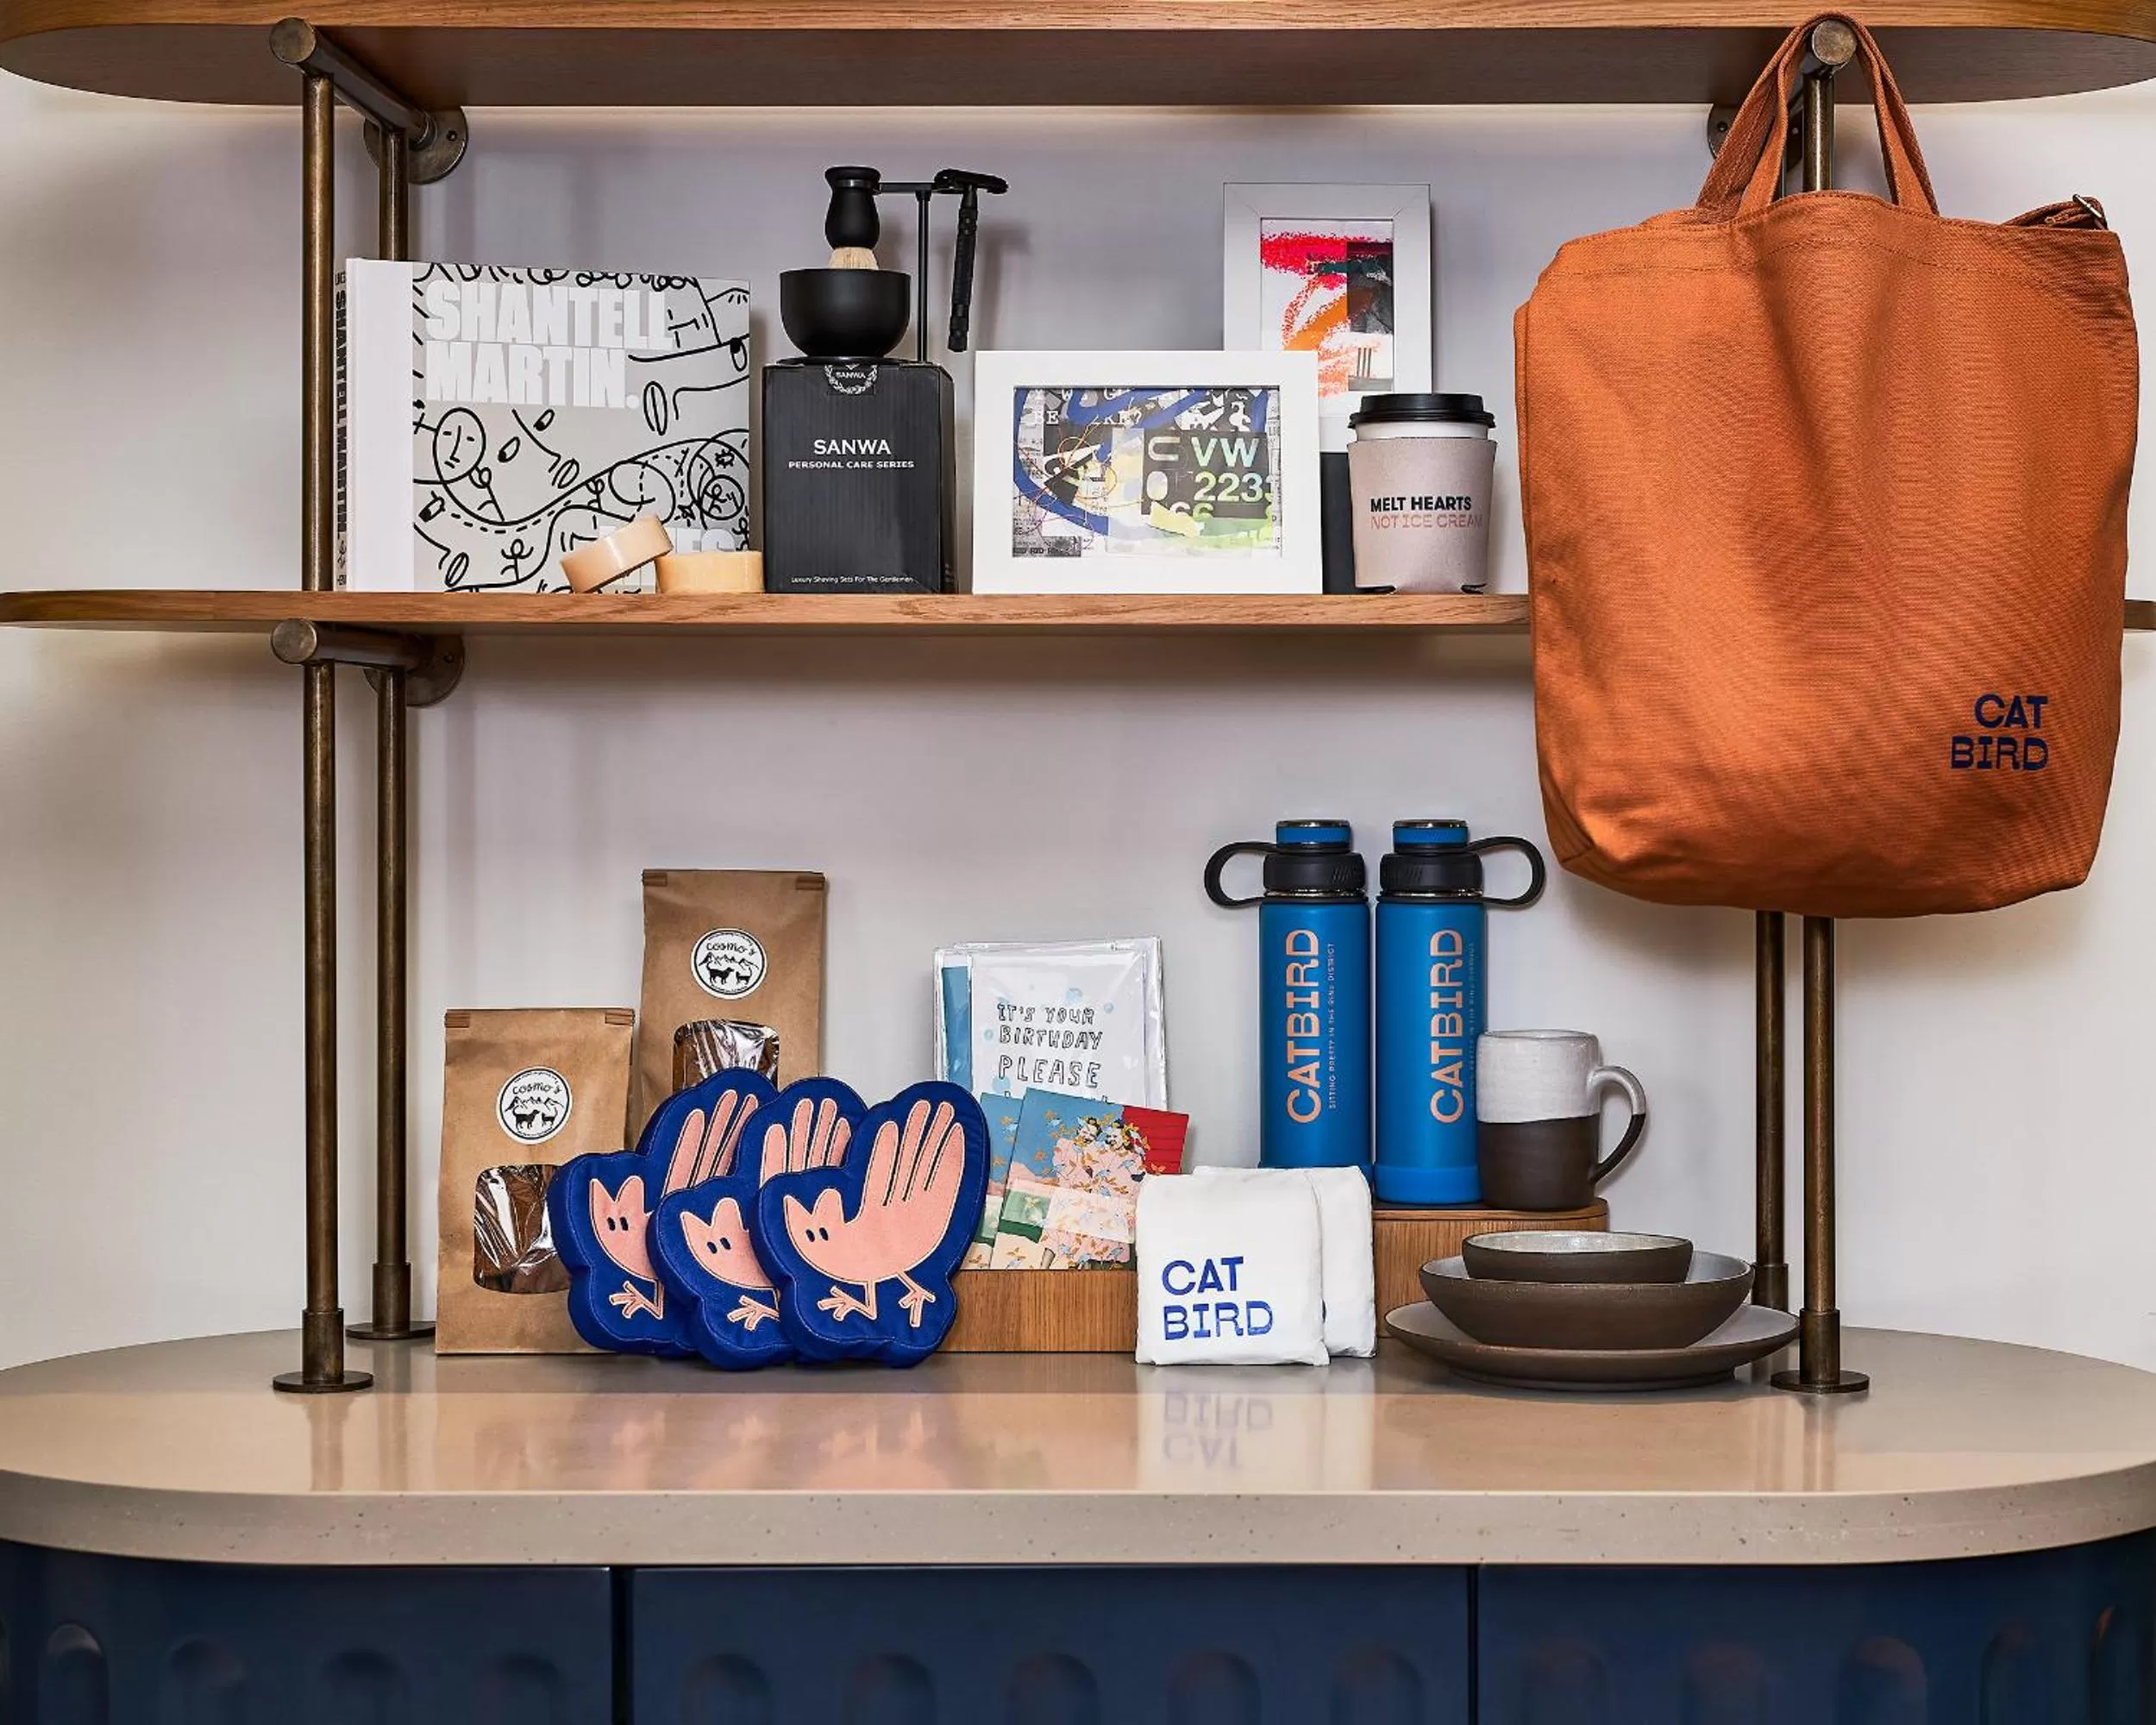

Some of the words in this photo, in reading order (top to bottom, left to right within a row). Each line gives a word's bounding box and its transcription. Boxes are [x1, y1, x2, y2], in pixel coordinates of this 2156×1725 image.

[425, 279, 676, 349] SHANTELL
[426, 342, 640, 409] MARTIN.
[814, 439, 892, 455] SANWA
[1191, 437, 1259, 467] VW
[1370, 497, 1406, 512] MELT
[1411, 496, 1472, 511] HEARTS
[1370, 514, 1397, 530] NOT
[1402, 514, 1432, 528] ICE
[1974, 693, 2048, 728] CAT
[1951, 736, 2048, 770] BIRD
[997, 1003, 1035, 1022] IT'S
[1045, 1007, 1094, 1025] YOUR
[1285, 929, 1321, 1123] CATBIRD
[1430, 929, 1464, 1123] CATBIRD
[1000, 1025, 1103, 1050] BIRTHDAY
[999, 1055, 1101, 1088] PLEASE
[1163, 1256, 1244, 1295] CAT
[1163, 1301, 1274, 1340] BIRD
